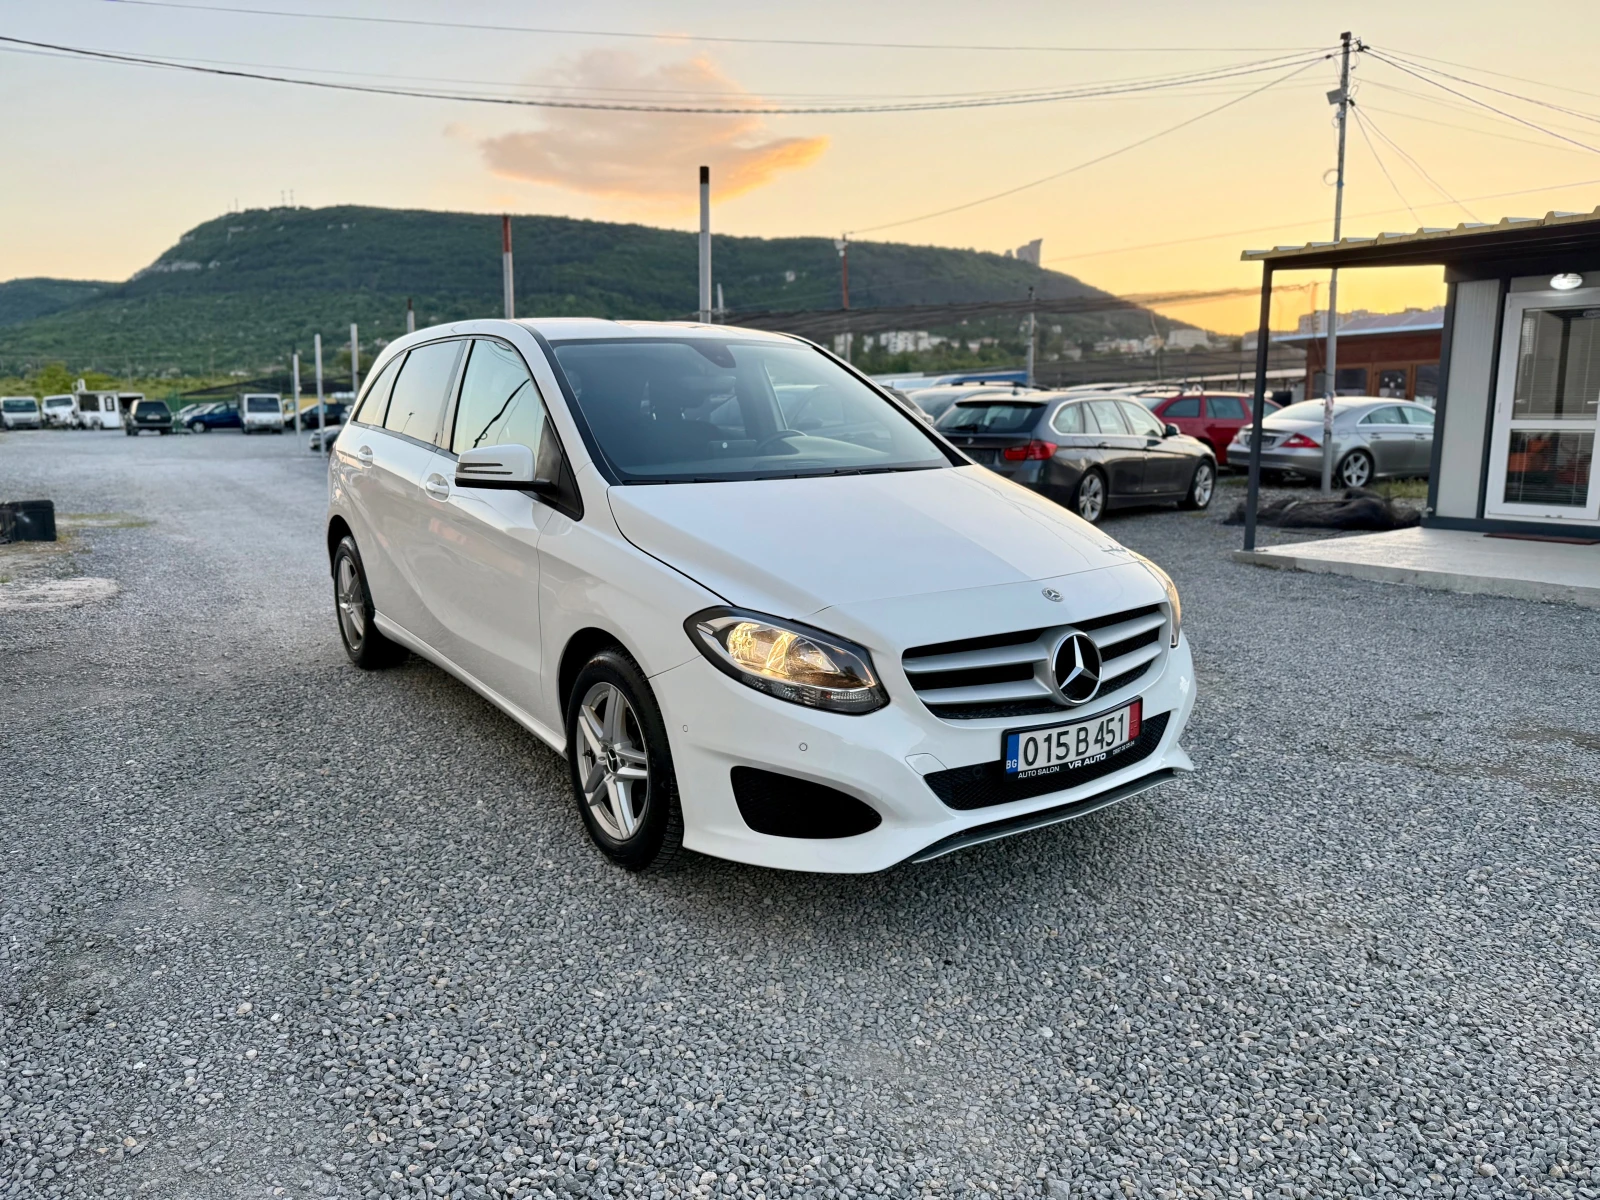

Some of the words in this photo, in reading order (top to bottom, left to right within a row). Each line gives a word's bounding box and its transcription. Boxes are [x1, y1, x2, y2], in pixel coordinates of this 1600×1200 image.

[1006, 759, 1018, 770] BG
[1067, 760, 1082, 770] VR
[1083, 752, 1107, 766] AUTO
[1018, 770, 1037, 779] AUTO
[1037, 765, 1060, 775] SALON
